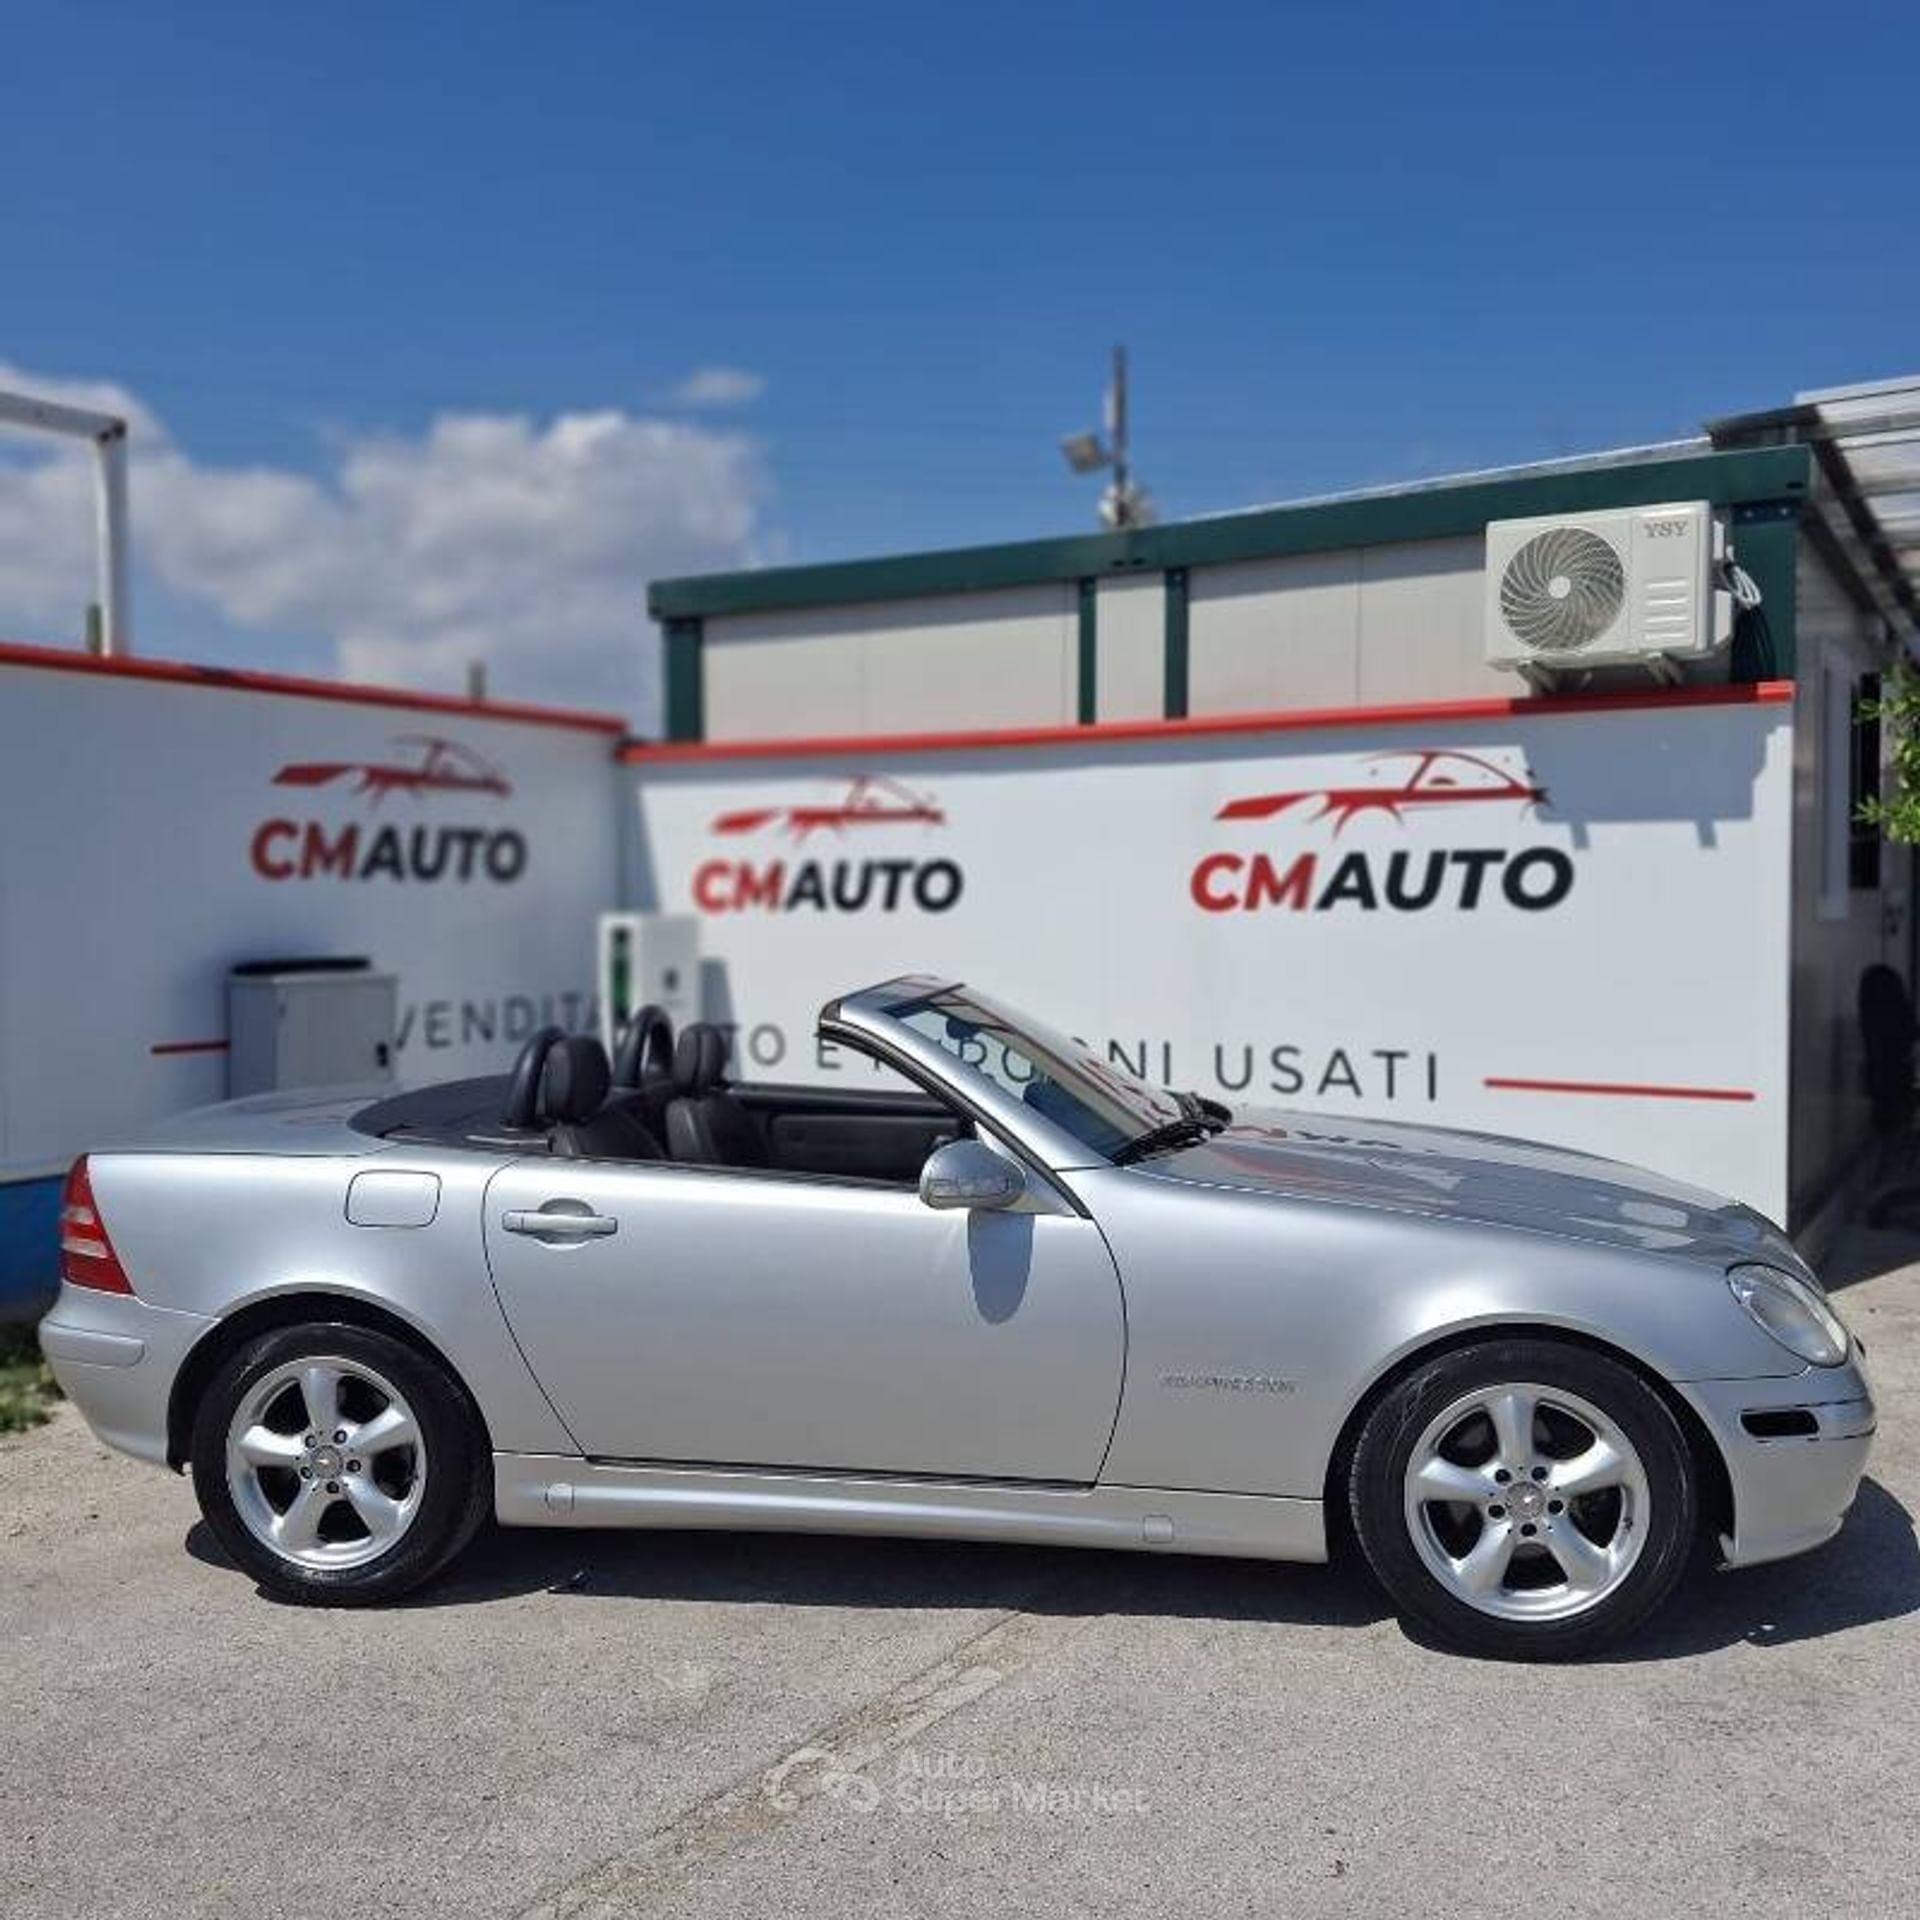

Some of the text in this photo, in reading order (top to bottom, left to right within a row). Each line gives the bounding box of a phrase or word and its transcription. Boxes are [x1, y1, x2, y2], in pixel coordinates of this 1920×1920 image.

[250, 818, 527, 883] CMAUTO
[1190, 846, 1574, 913] CMAUTO
[692, 858, 965, 914] CMAUTO
[1213, 1043, 1438, 1101] USATI
